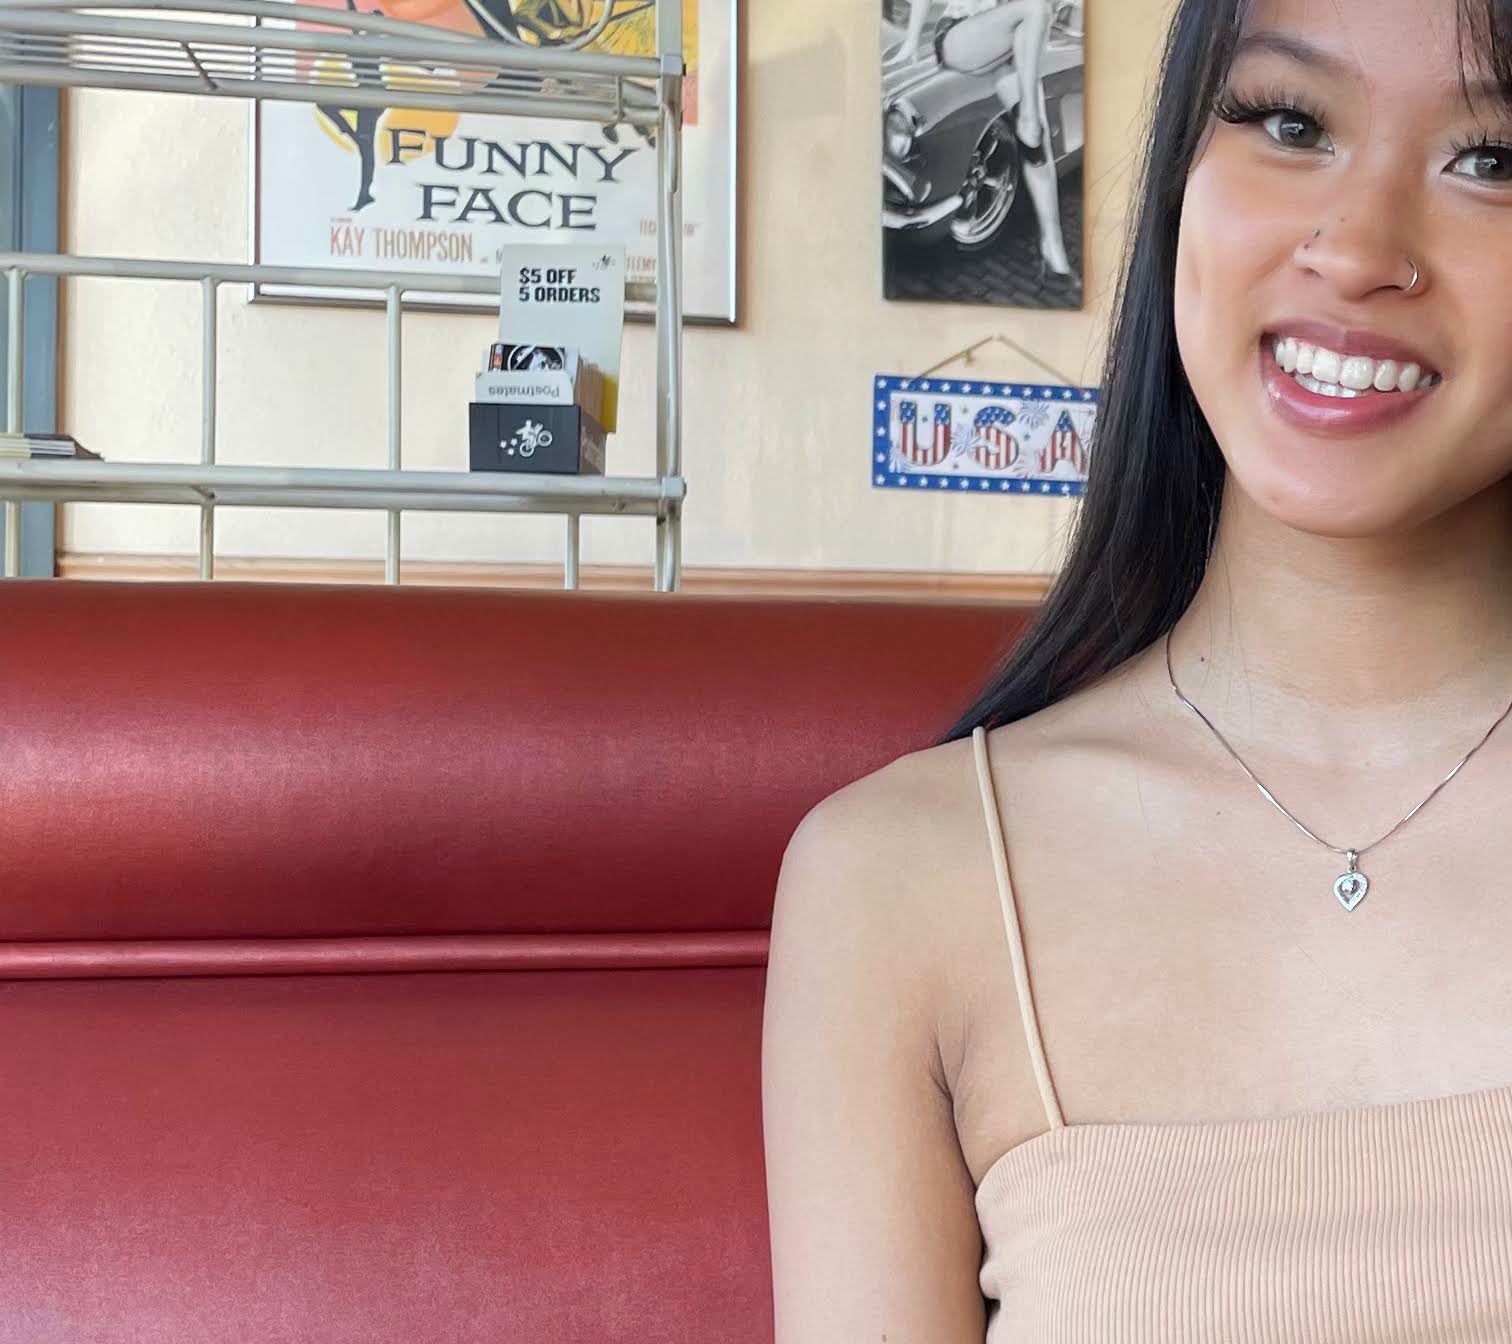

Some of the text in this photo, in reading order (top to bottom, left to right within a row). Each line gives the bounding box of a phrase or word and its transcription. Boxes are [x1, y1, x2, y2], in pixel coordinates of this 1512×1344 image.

[386, 128, 641, 183] FUNNY
[416, 183, 598, 230] FACE
[329, 225, 365, 257] KAY
[373, 227, 473, 263] THOMPSON
[519, 267, 577, 285] $5 OFF
[518, 287, 600, 304] 5 ORDERS
[488, 385, 560, 398] Postmates
[899, 400, 1090, 474] USA
